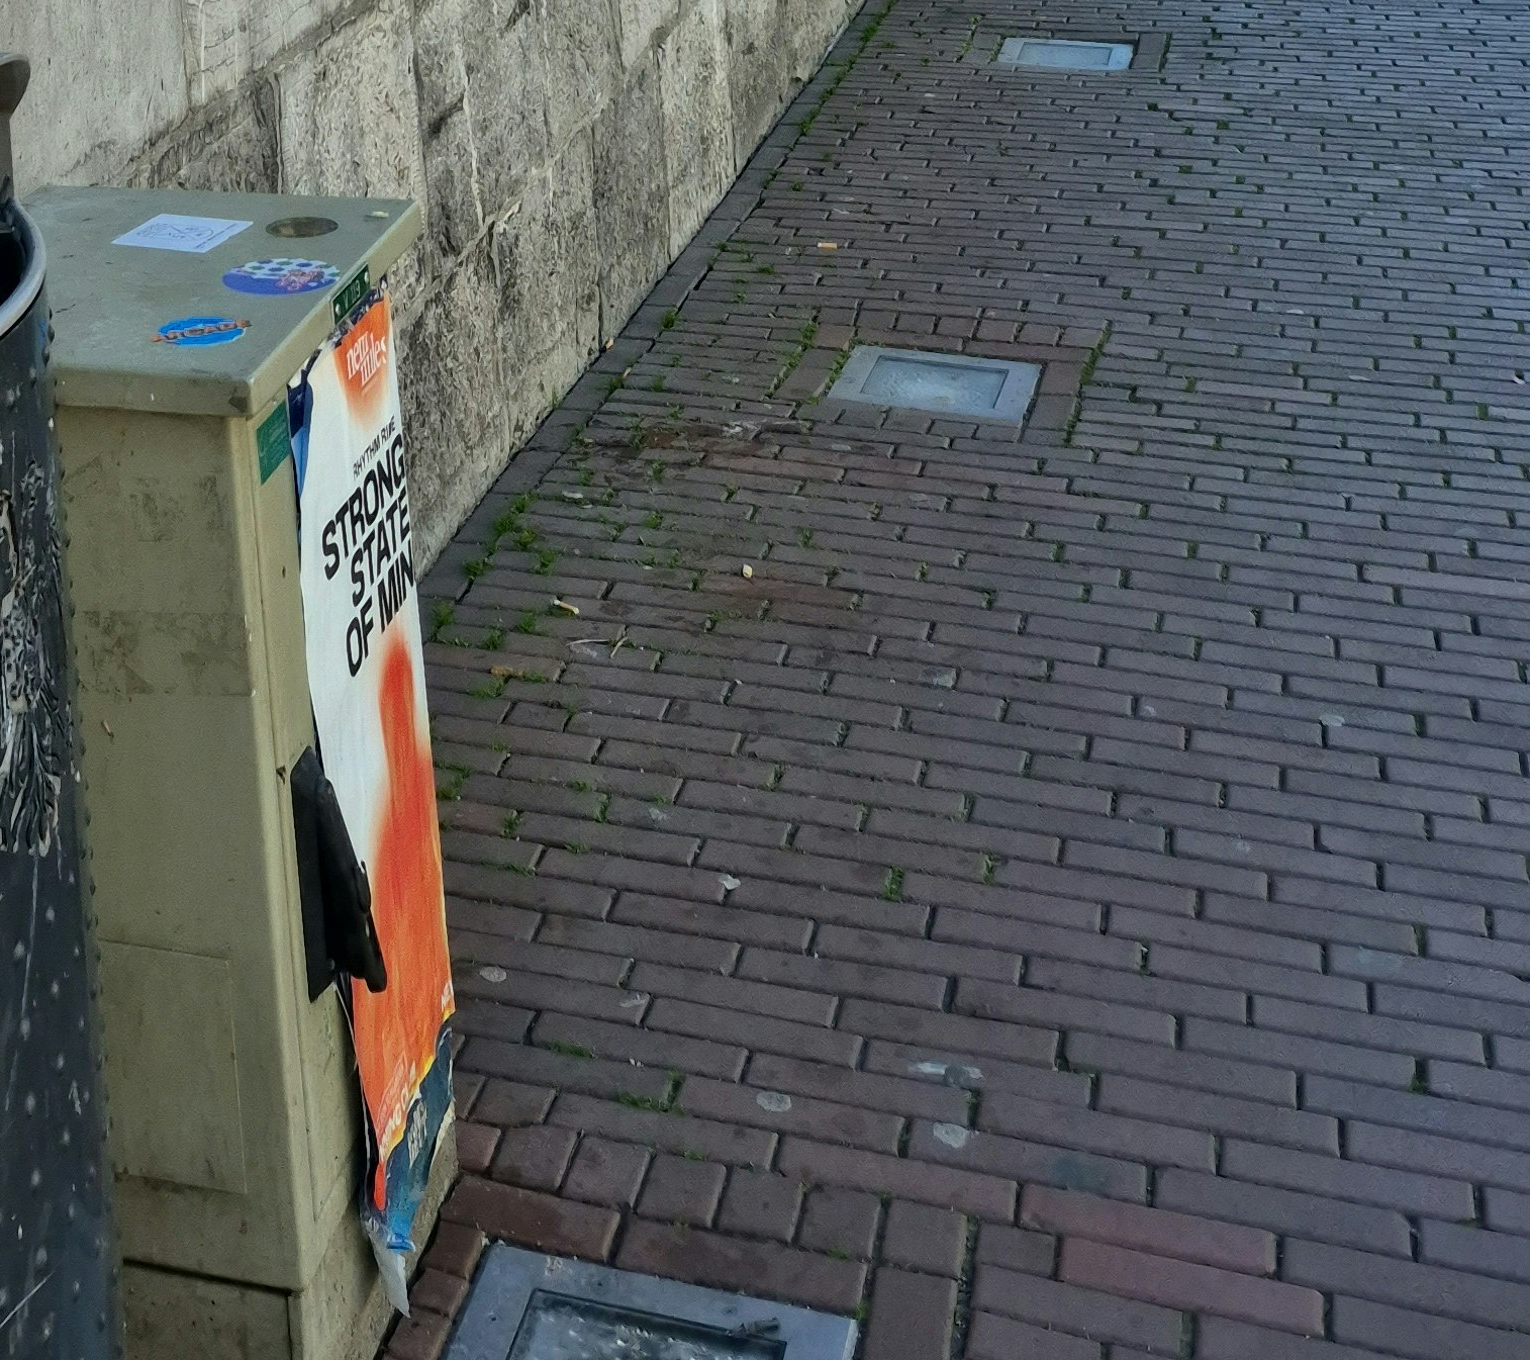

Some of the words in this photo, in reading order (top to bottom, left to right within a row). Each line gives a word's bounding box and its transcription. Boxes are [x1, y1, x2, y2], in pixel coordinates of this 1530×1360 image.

[322, 433, 405, 581] STRONG
[353, 434, 381, 481] RHYTHM
[351, 486, 410, 608] STATE
[346, 595, 374, 678] OF
